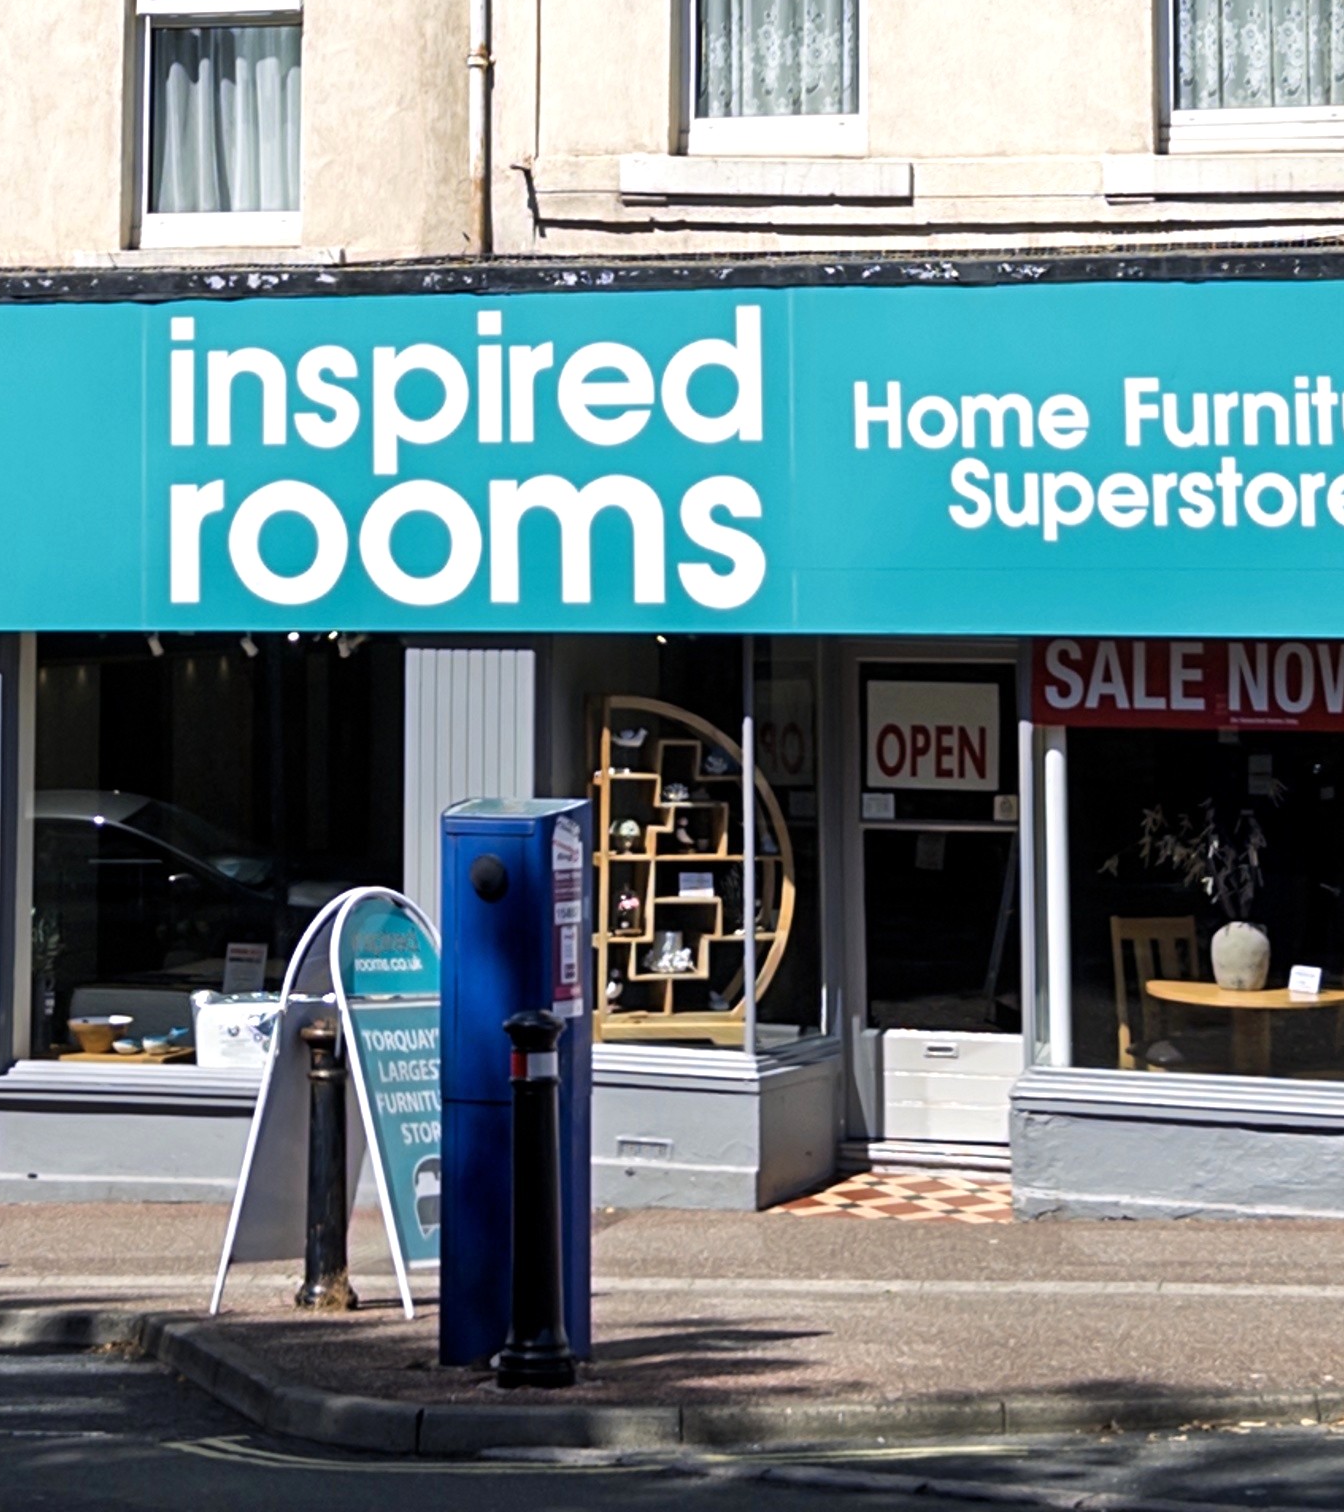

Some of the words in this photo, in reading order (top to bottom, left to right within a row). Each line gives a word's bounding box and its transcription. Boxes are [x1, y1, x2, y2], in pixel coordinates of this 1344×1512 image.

[170, 304, 763, 476] inspired
[854, 380, 1089, 450] Home
[170, 474, 766, 609] rooms
[1044, 639, 1205, 710] SALE
[875, 723, 987, 780] OPEN
[361, 1028, 440, 1053] TORQUAY'
[378, 1059, 441, 1083] LARGES
[400, 1121, 441, 1145] STOR
